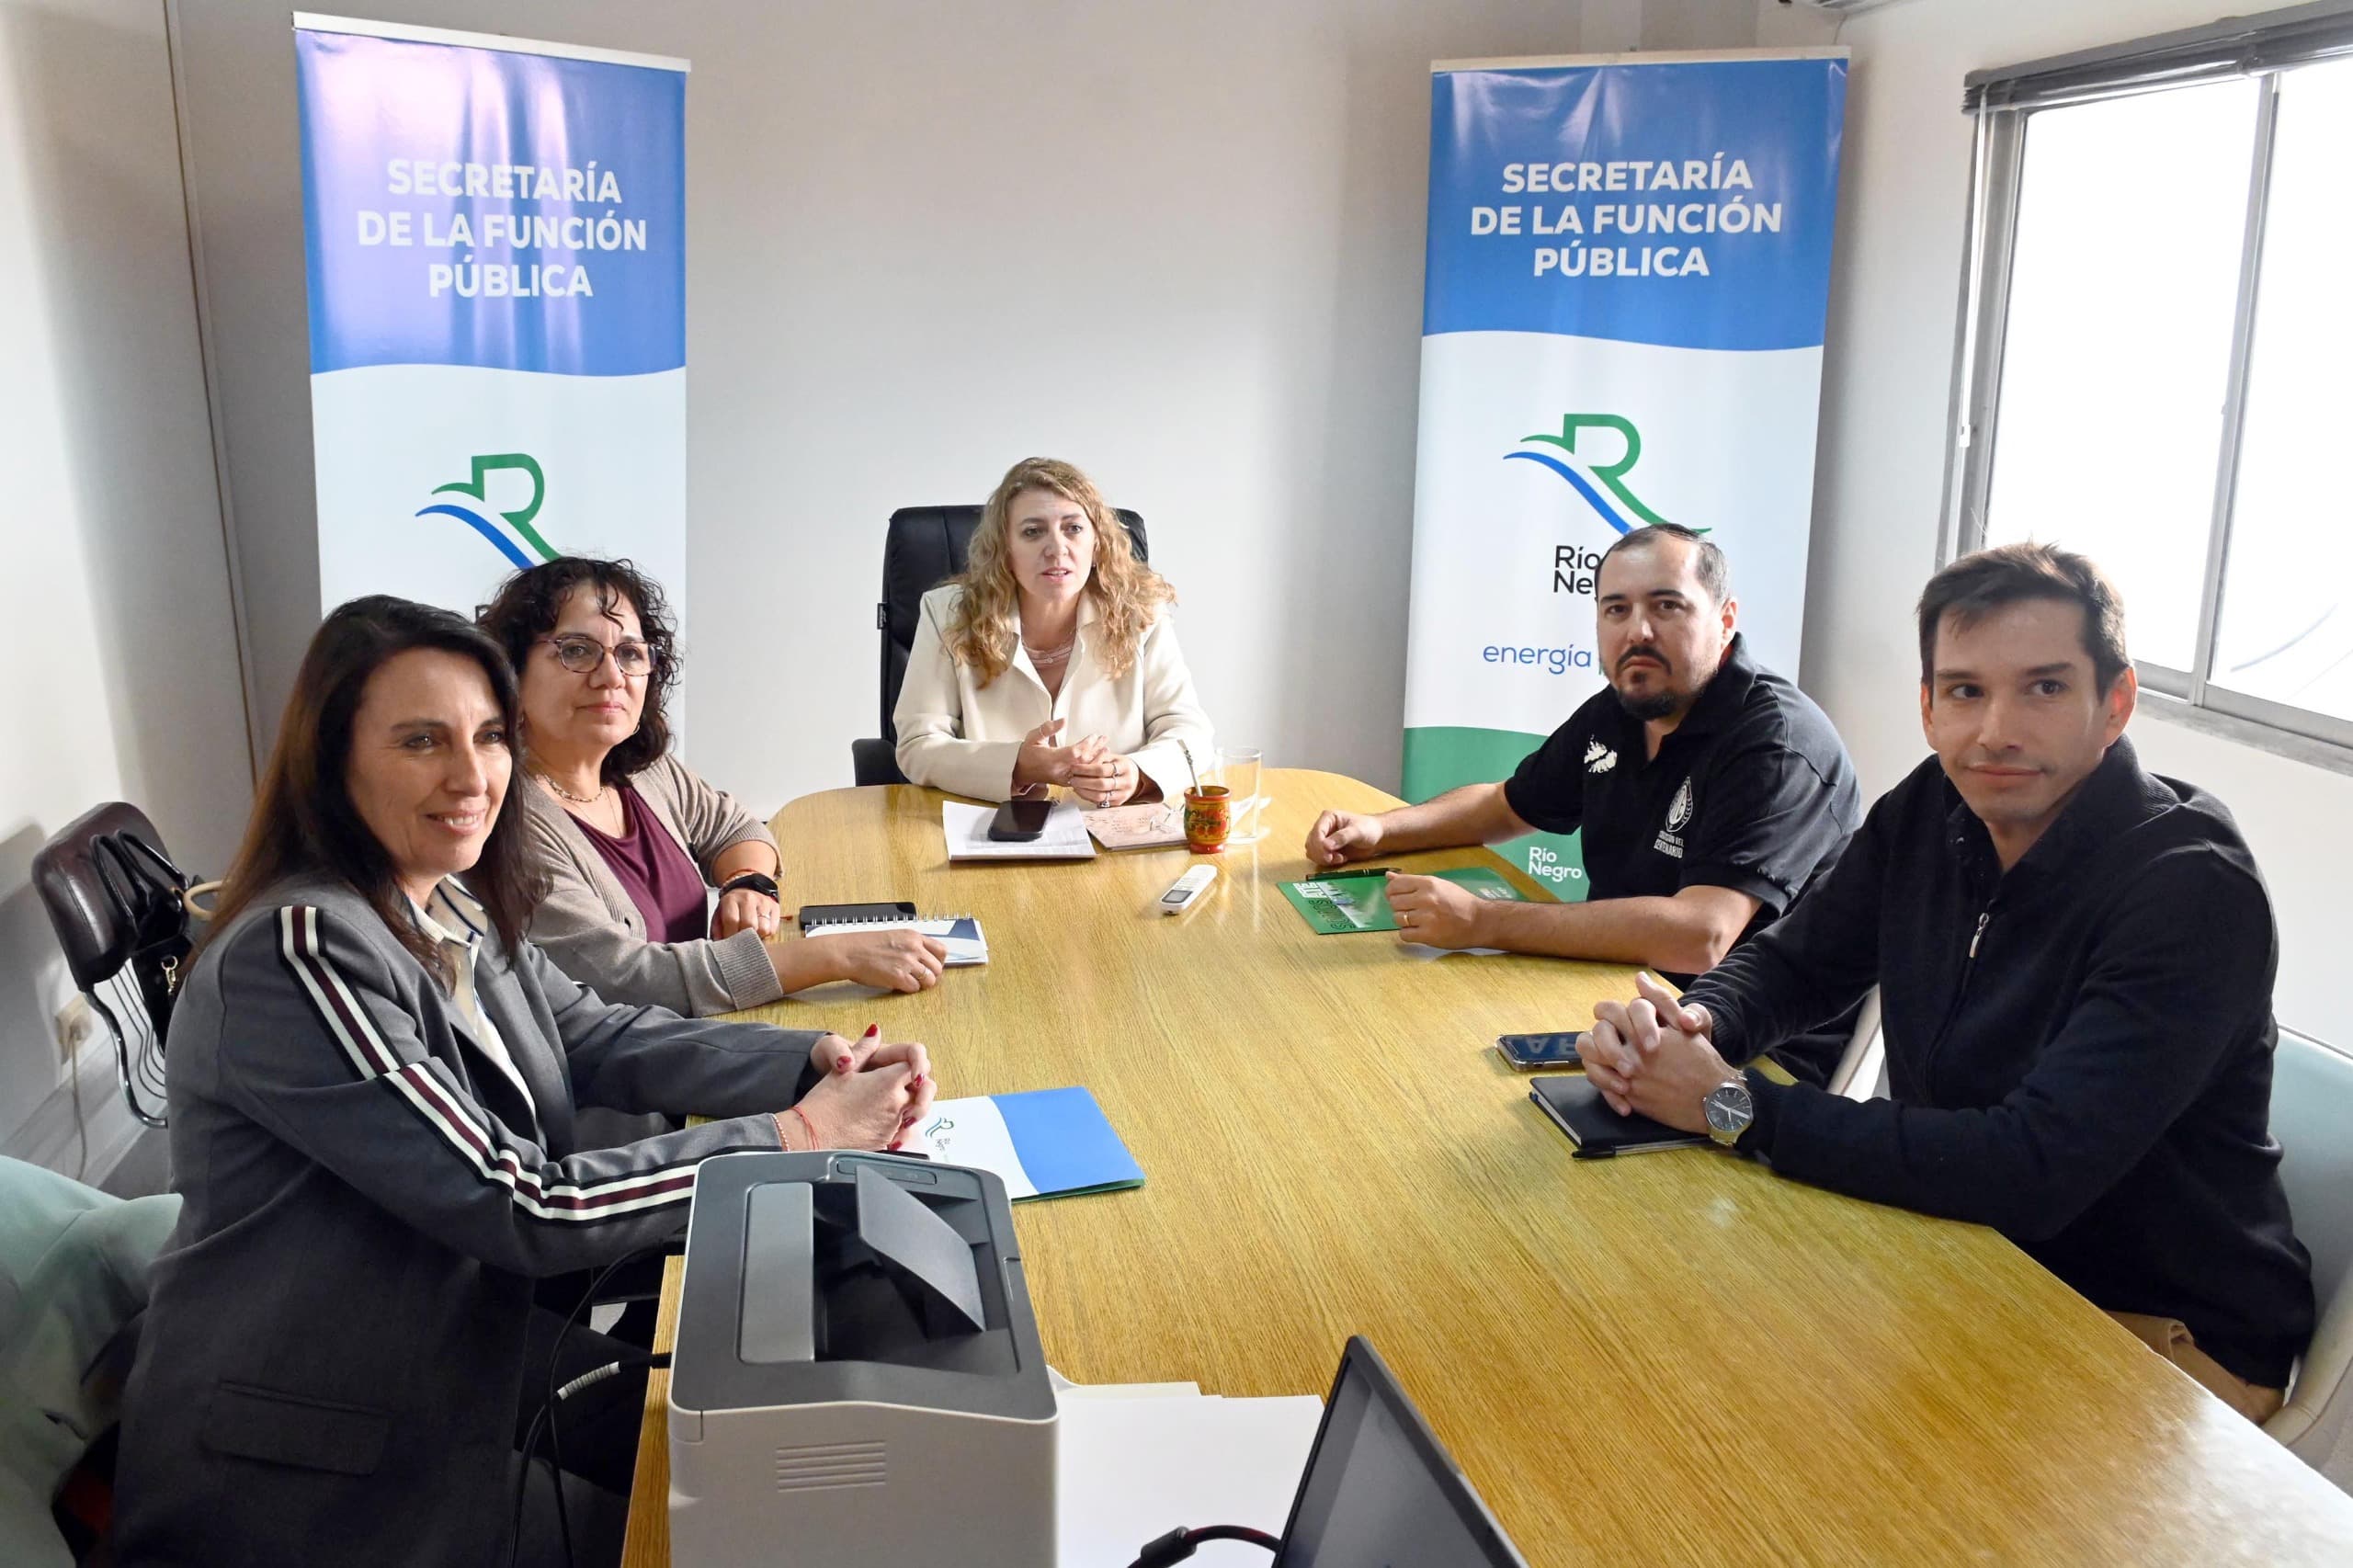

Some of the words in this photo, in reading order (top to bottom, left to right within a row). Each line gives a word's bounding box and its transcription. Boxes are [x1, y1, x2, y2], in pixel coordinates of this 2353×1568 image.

[387, 158, 623, 204] SECRETARÍA
[1502, 151, 1755, 194] SECRETARÍA
[358, 210, 414, 247] DE
[423, 212, 476, 248] LA
[483, 210, 647, 251] FUNCIÓN
[1471, 206, 1522, 236] DE
[1532, 205, 1585, 235] LA
[1593, 195, 1782, 235] FUNCIÓN
[429, 254, 594, 298] PÚBLICA
[1534, 239, 1711, 278] PÚBLICA
[1554, 545, 1600, 570] Río
[1483, 644, 1592, 675] energía
[1528, 860, 1583, 883] Negro
[1529, 846, 1558, 863] Río
